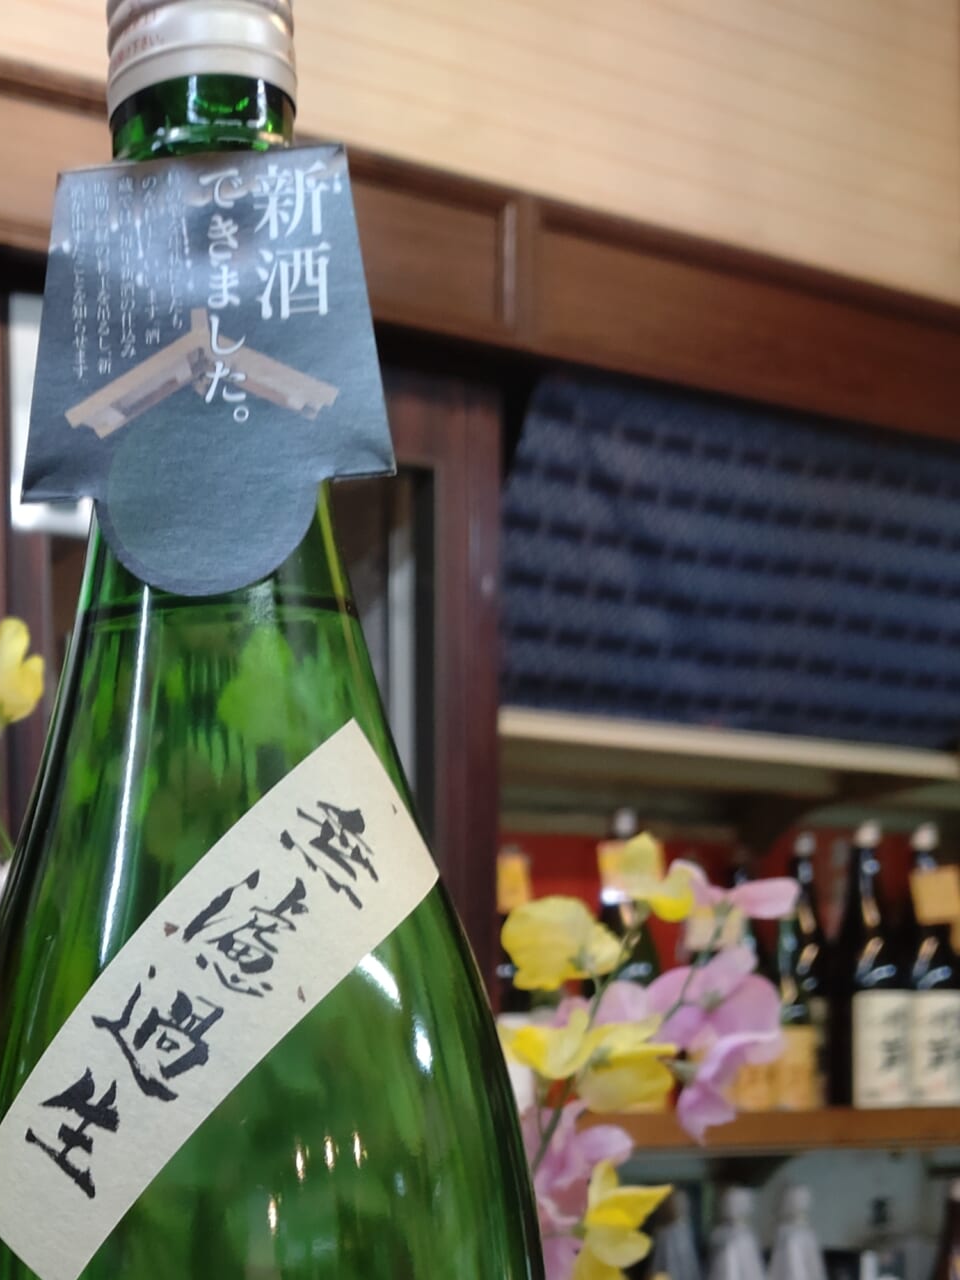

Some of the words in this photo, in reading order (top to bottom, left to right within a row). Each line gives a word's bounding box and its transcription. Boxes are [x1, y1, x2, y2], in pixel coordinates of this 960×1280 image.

[199, 168, 249, 423] できました。
[252, 160, 331, 321] 新酒
